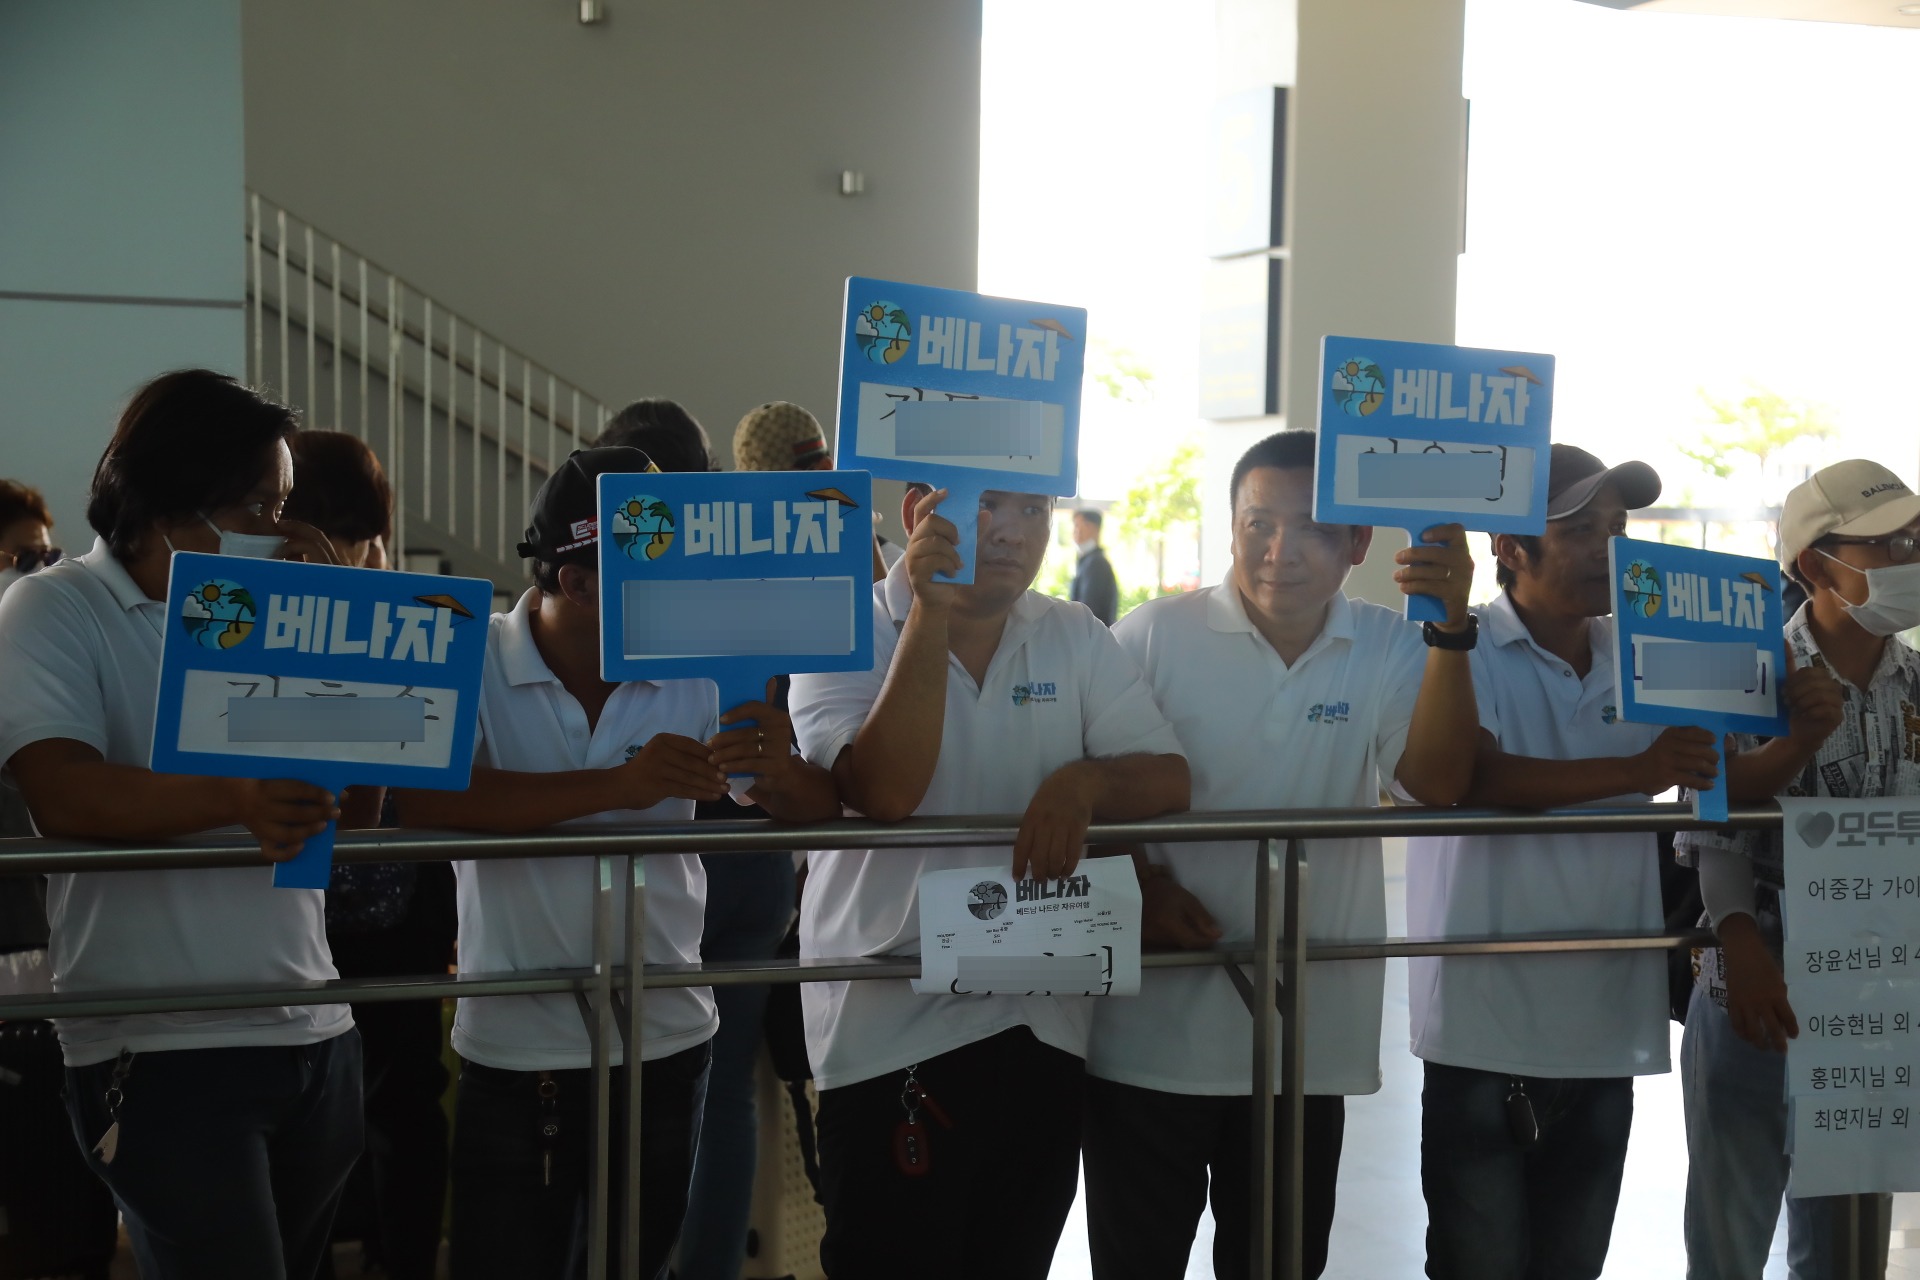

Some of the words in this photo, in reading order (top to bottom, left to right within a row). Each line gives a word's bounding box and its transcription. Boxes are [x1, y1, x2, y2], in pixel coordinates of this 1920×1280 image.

[917, 315, 1060, 381] 베나자
[1392, 368, 1530, 426] 베나자
[683, 500, 844, 556] 베나자
[1666, 571, 1766, 630] 베나자
[264, 594, 454, 664] 베나자
[1836, 810, 1920, 847] 모두투
[1016, 875, 1091, 902] 베나자
[1808, 877, 1873, 901] 어중갑
[1882, 875, 1920, 899] 가이
[1806, 946, 1881, 974] 장윤선님
[1891, 944, 1907, 966] 외
[1808, 1012, 1883, 1037] 이승현님
[1893, 1011, 1909, 1034] 외
[1811, 1065, 1885, 1090] 홍민지님
[1894, 1065, 1911, 1087] 외
[1814, 1106, 1883, 1131] 최연지님
[1891, 1106, 1909, 1129] 외
